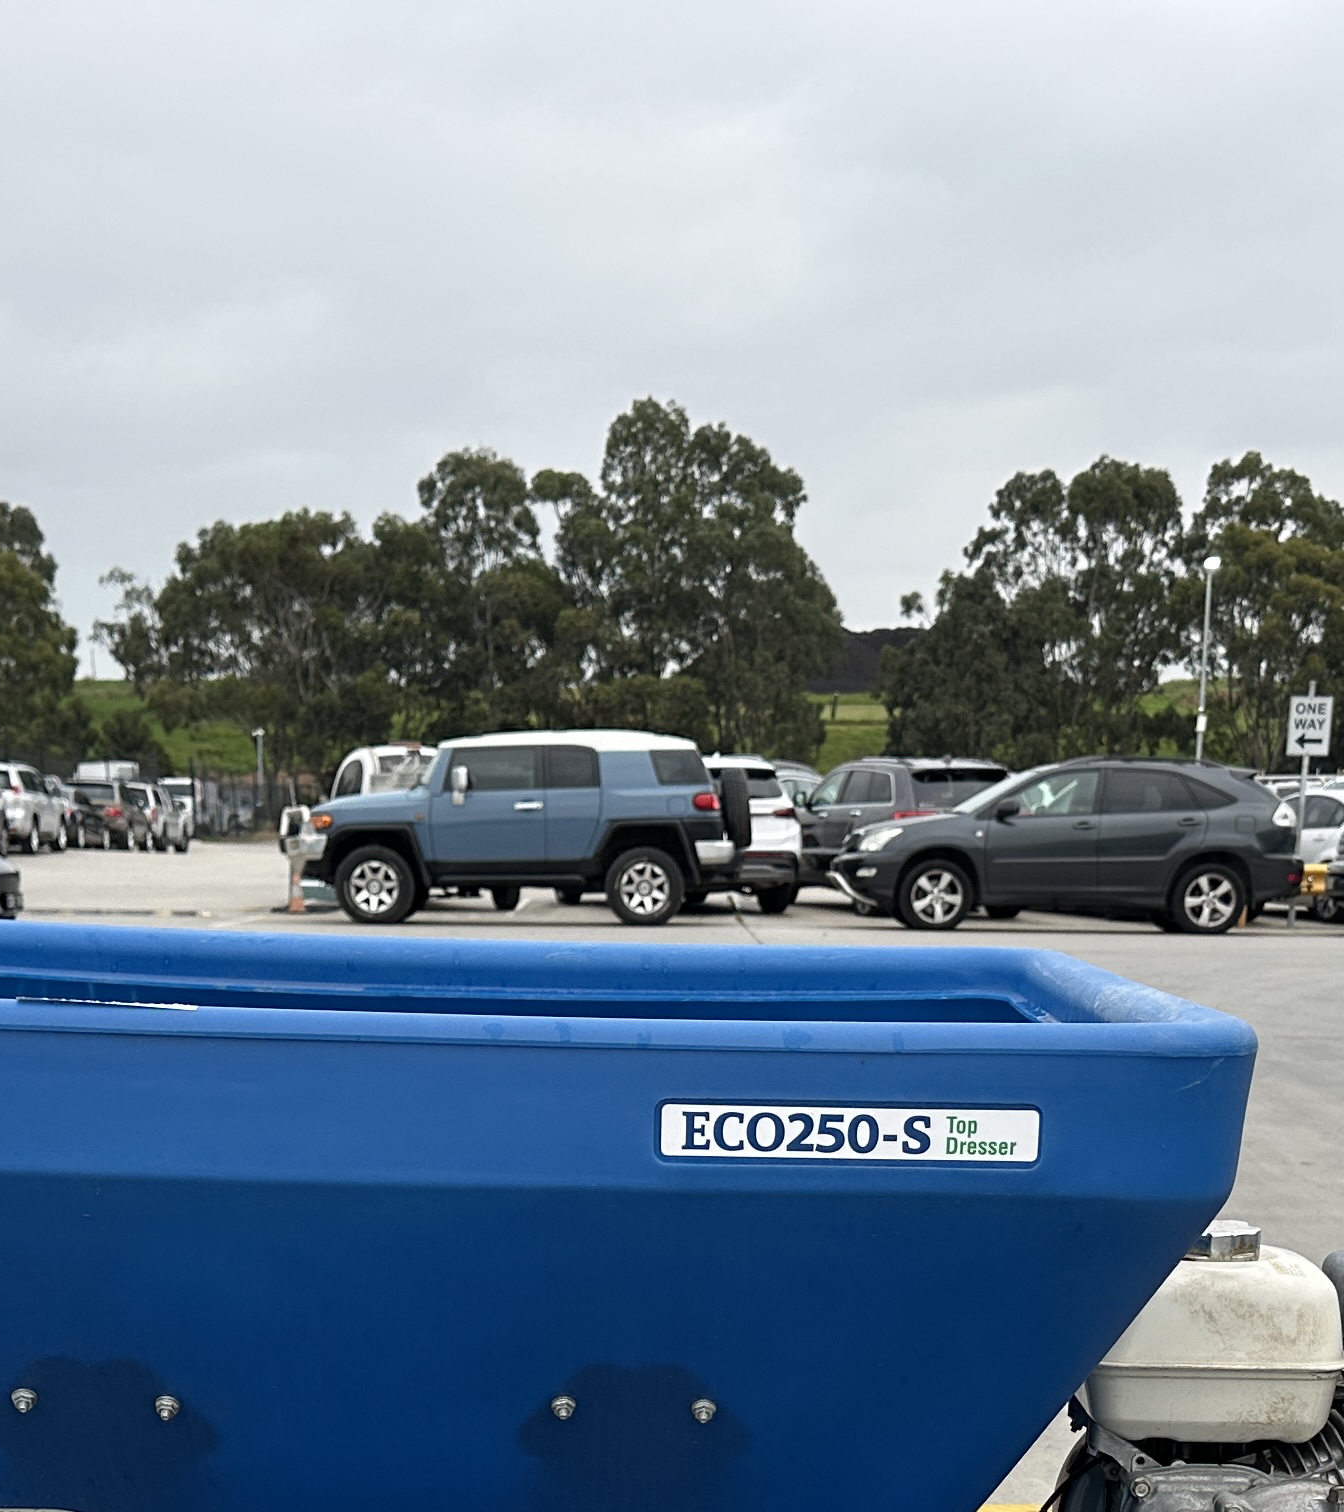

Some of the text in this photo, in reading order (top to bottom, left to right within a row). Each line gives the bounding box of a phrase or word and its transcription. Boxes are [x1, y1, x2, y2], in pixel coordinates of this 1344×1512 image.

[1295, 702, 1327, 715] ONE
[1294, 718, 1327, 731] WAY
[681, 1111, 931, 1155] ECO250-S
[946, 1116, 978, 1134] Top
[946, 1137, 1017, 1156] Dresser
